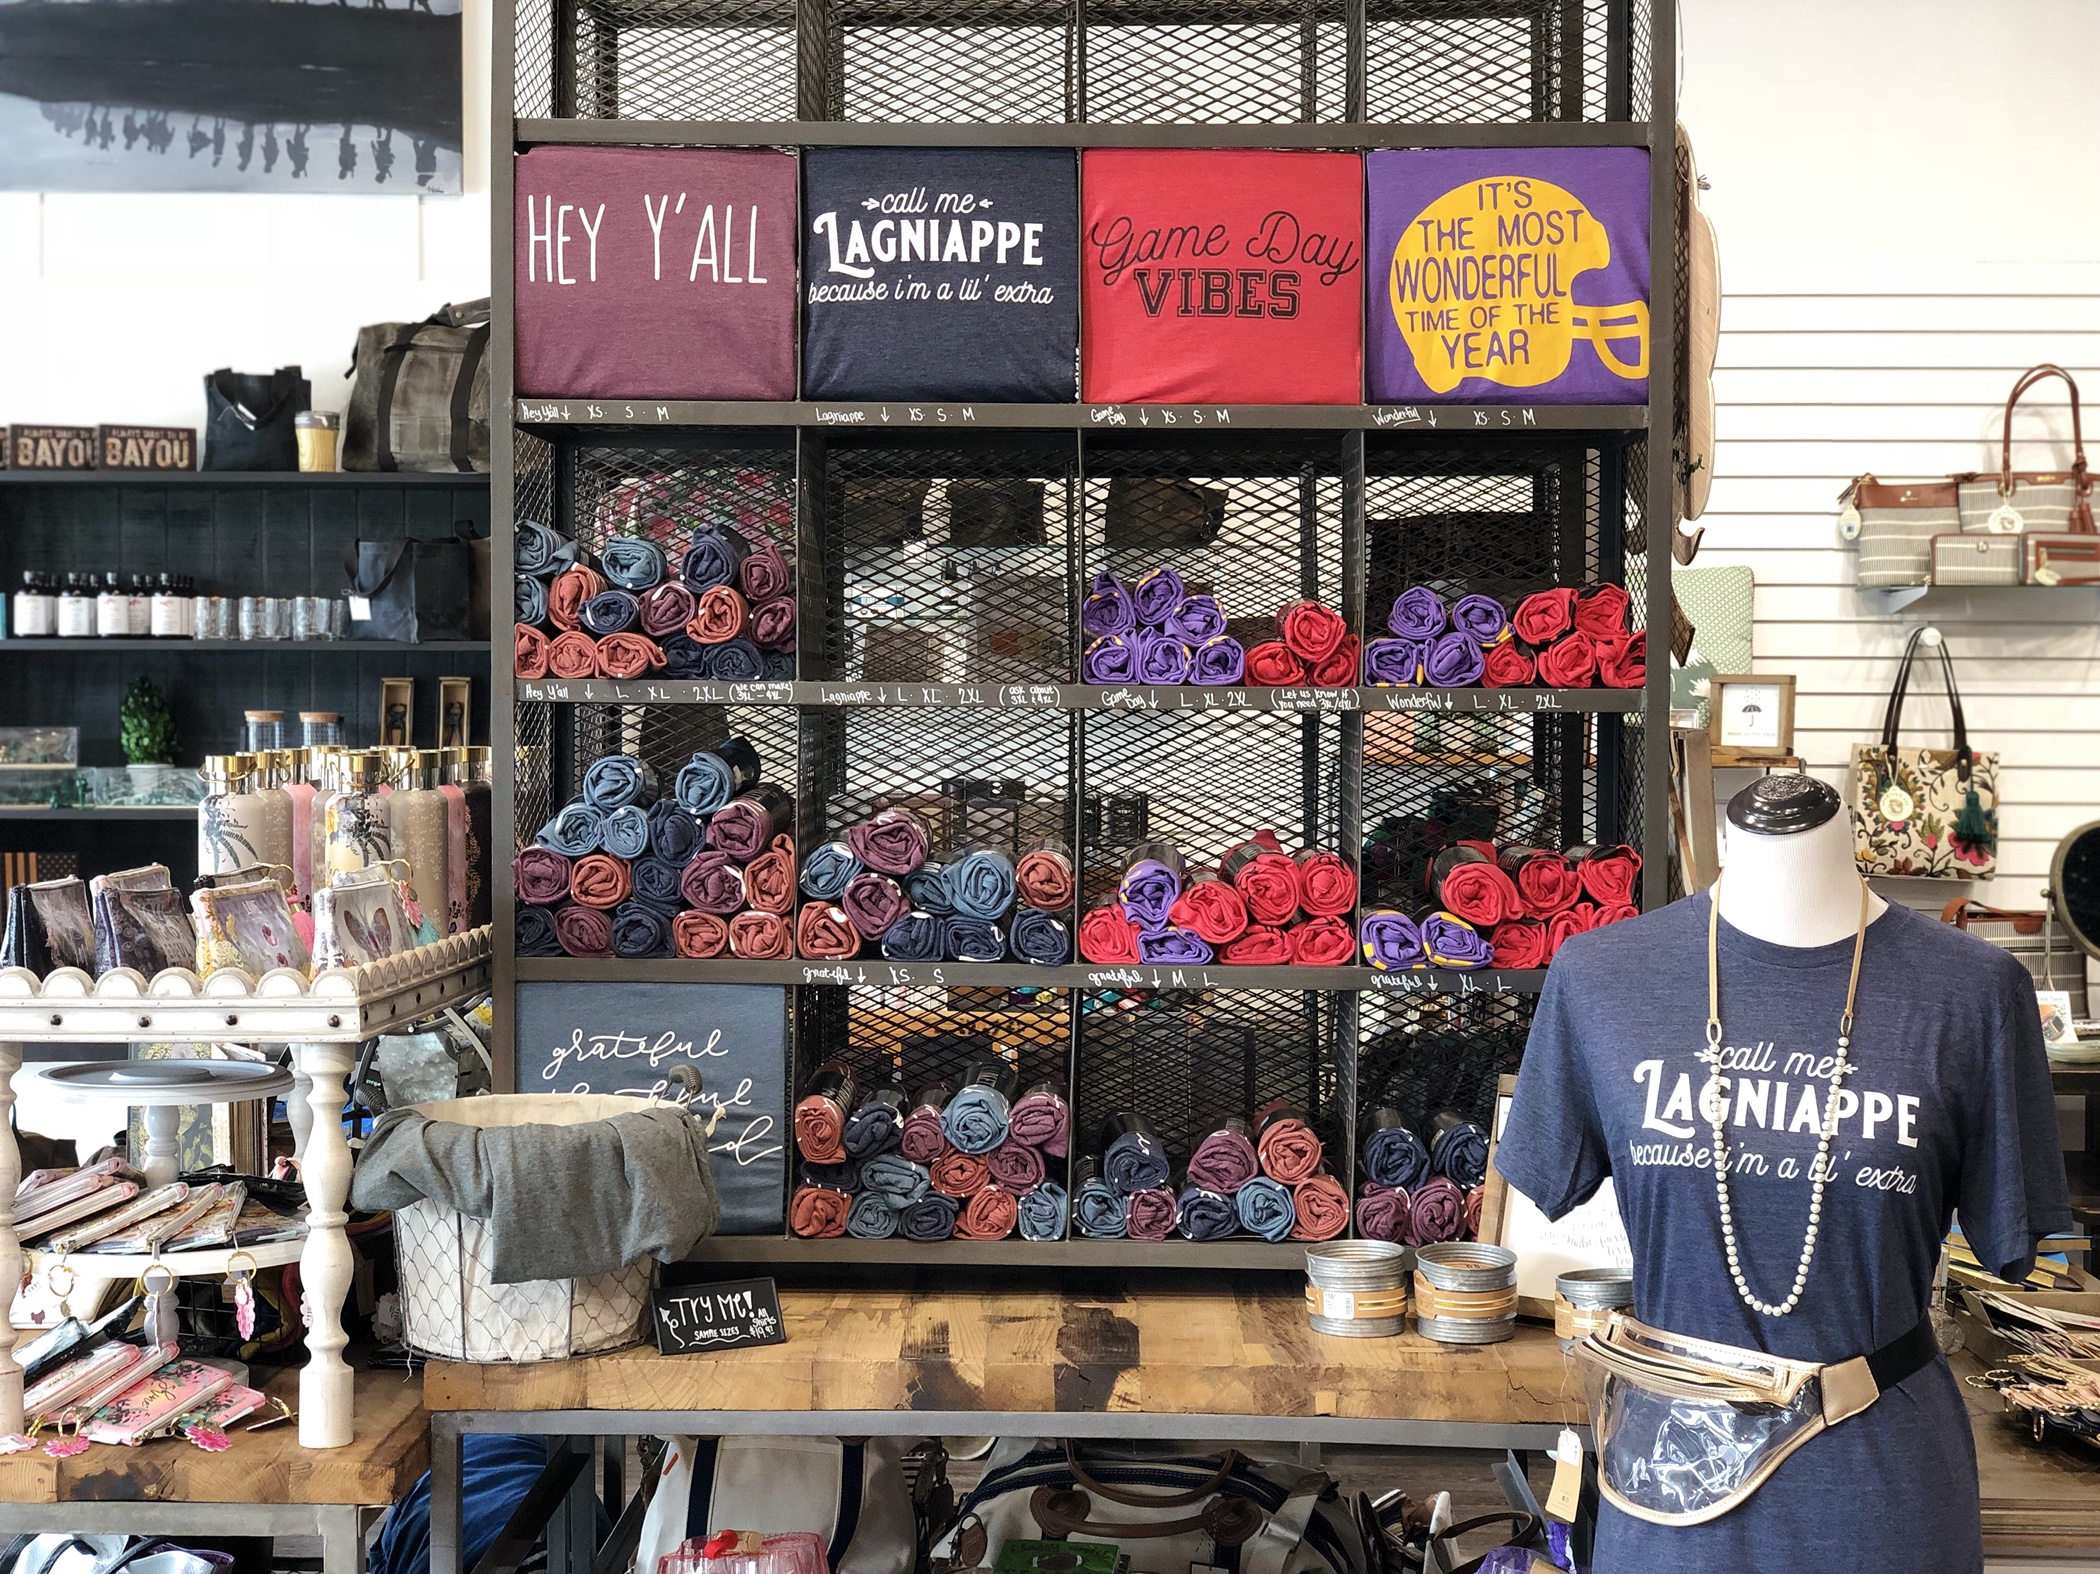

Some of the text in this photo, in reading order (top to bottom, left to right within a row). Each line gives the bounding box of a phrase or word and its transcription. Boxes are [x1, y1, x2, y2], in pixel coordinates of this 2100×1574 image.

[880, 186, 977, 215] call me
[1476, 180, 1534, 211] IT'S
[528, 192, 769, 285] HEY Y'ALL
[1416, 208, 1586, 252] THE MOST
[812, 211, 1045, 279] LAGNIAPPE
[1091, 210, 1361, 287] Game Day
[808, 278, 890, 306] because
[937, 283, 954, 301] a
[993, 281, 1055, 305] extra
[1394, 252, 1567, 304] WONDERFUL
[1133, 268, 1302, 318] VIBES
[1404, 302, 1561, 332] TIME OF THE
[1440, 330, 1531, 369] YEAR
[625, 405, 635, 419] S
[656, 406, 670, 421] M
[815, 407, 866, 425] Lagniappe
[937, 408, 948, 422] S
[962, 407, 976, 421] M
[1090, 406, 1115, 423] Game
[1193, 410, 1204, 424] S
[1215, 409, 1231, 424] M
[1107, 411, 1128, 426] Day
[1371, 406, 1422, 427] Wonderful
[1500, 410, 1512, 426] S
[1522, 408, 1537, 426] M
[106, 437, 190, 469] BAYOU
[525, 684, 543, 699] Hey
[616, 686, 629, 699] L
[692, 687, 724, 701] 2XL
[821, 688, 872, 707] Lagniappe
[898, 687, 908, 702] L
[959, 688, 984, 703] 2XL
[1101, 688, 1132, 707] Game
[1180, 693, 1193, 707] L
[1227, 692, 1252, 706] 2XL
[1386, 692, 1441, 710] Wonderful
[1473, 695, 1487, 709] L
[1536, 695, 1562, 709] 2XL
[803, 965, 852, 984] grateful
[933, 970, 944, 983] S
[1088, 968, 1219, 988] grateful M L
[1371, 974, 1422, 991] grateful
[1497, 976, 1512, 992] L
[542, 1028, 729, 1080] grateful
[1719, 1042, 1838, 1079] call me
[1633, 1059, 1920, 1148] LAGNIAPPE
[1630, 1139, 1712, 1168] because
[1777, 1157, 1799, 1179] a
[1855, 1165, 1917, 1195] extra
[669, 1290, 755, 1327] Try Me!
[719, 1326, 740, 1338] SIZES
